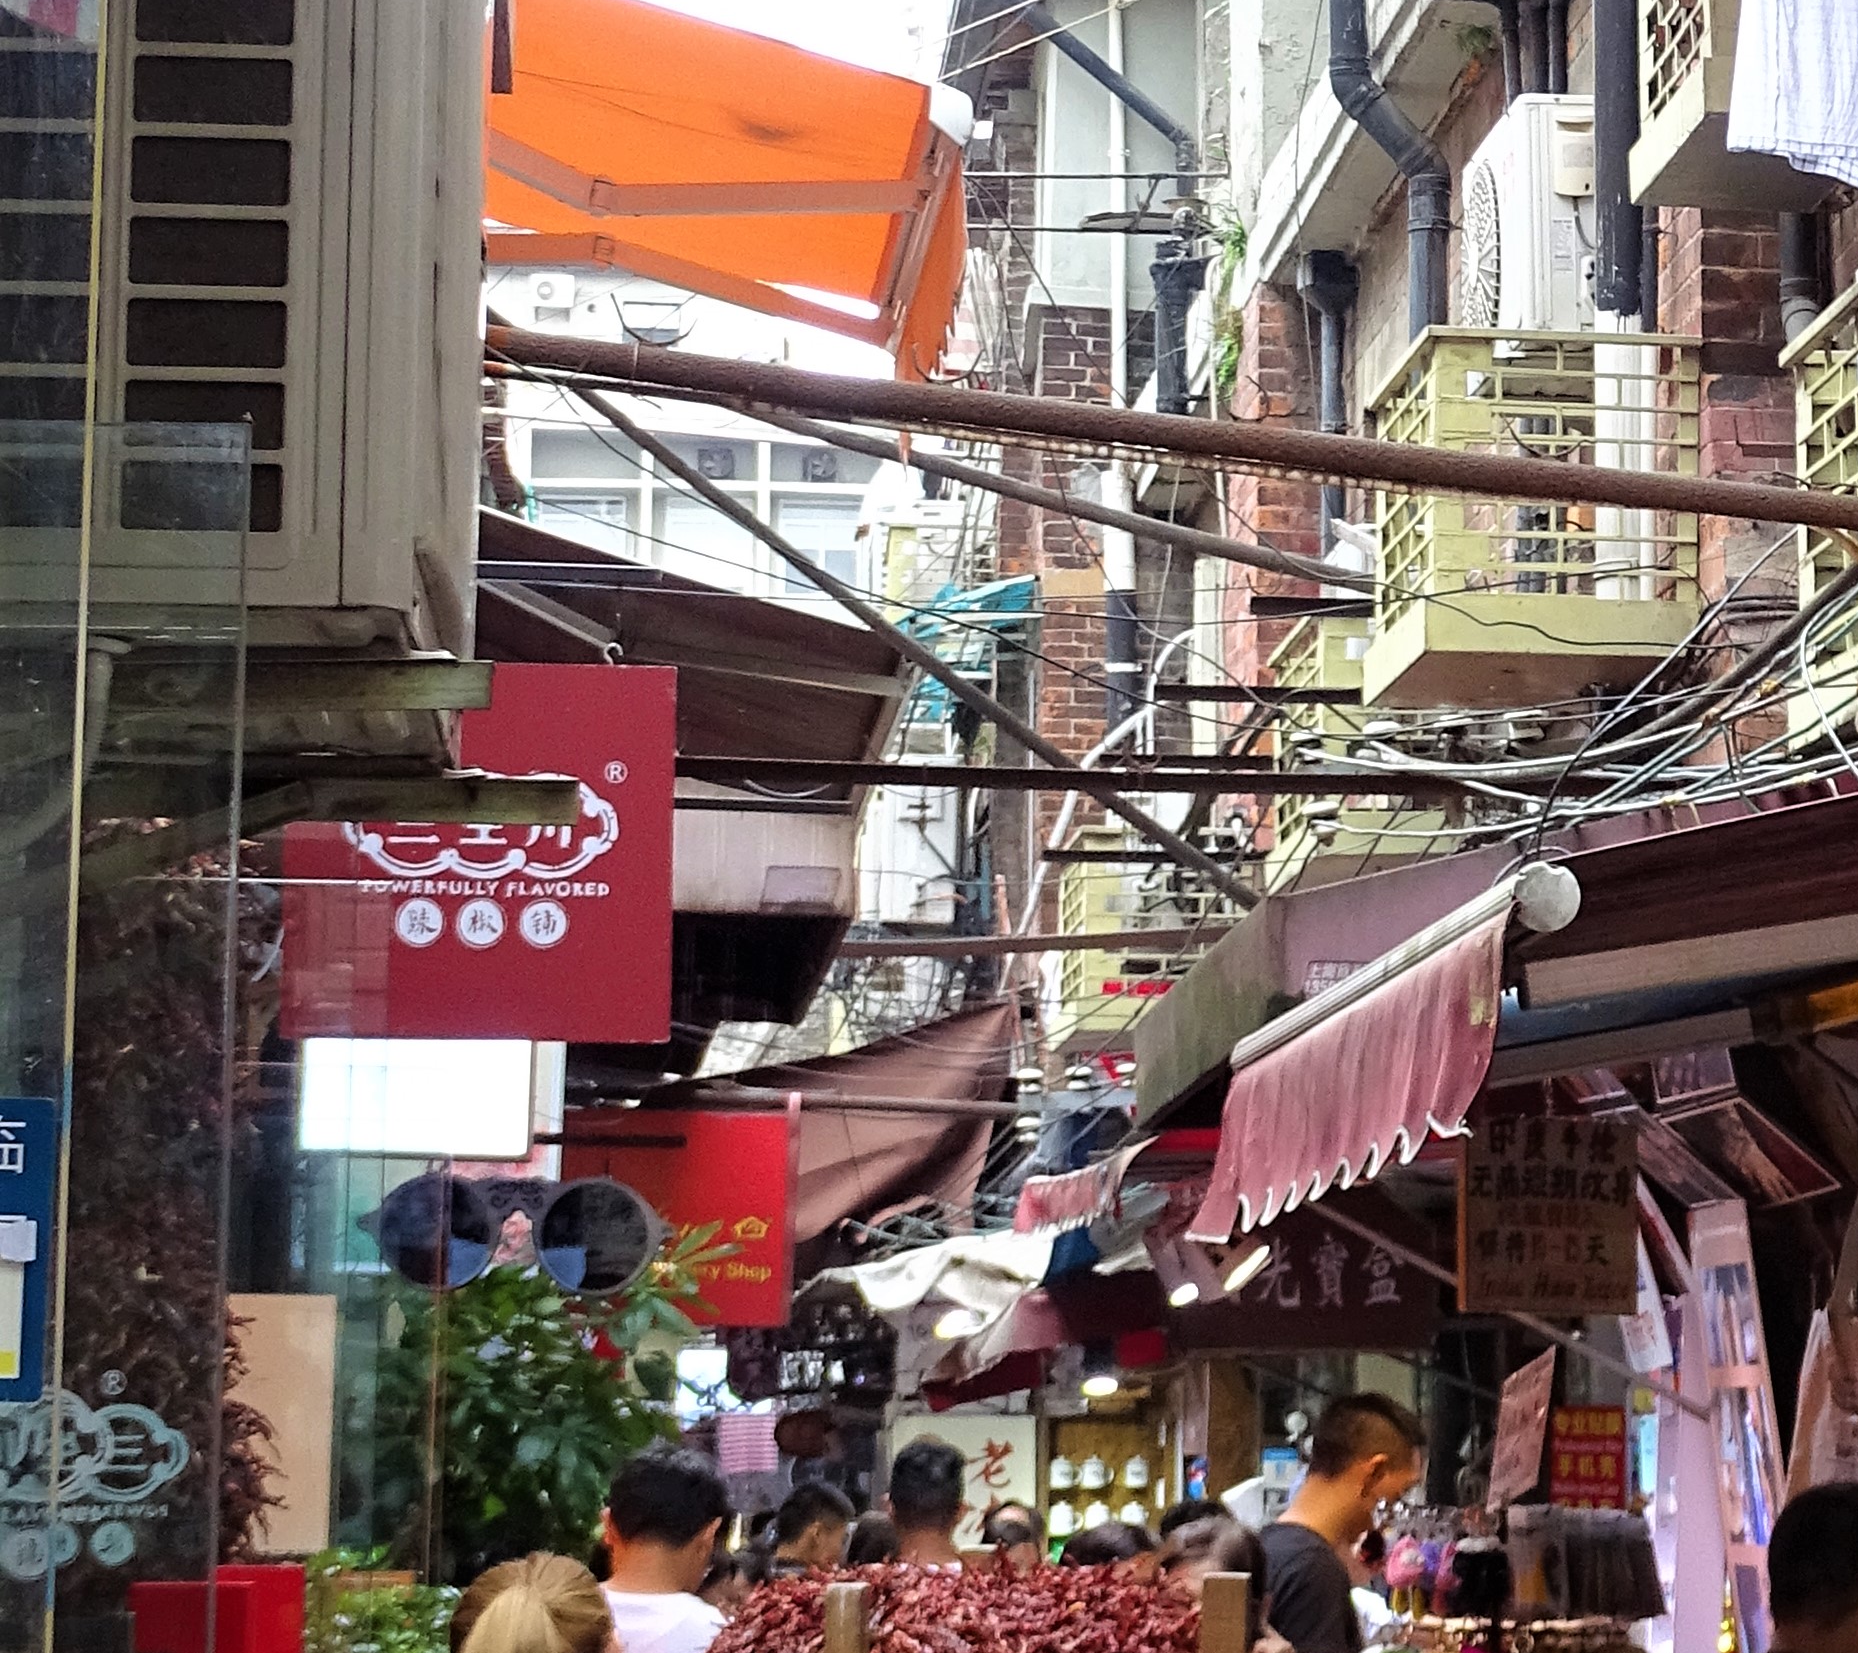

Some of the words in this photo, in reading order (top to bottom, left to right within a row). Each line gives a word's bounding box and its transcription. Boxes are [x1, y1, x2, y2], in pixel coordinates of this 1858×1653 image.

[506, 881, 611, 897] FLAVORED
[1250, 1234, 1402, 1310] 光寶盒
